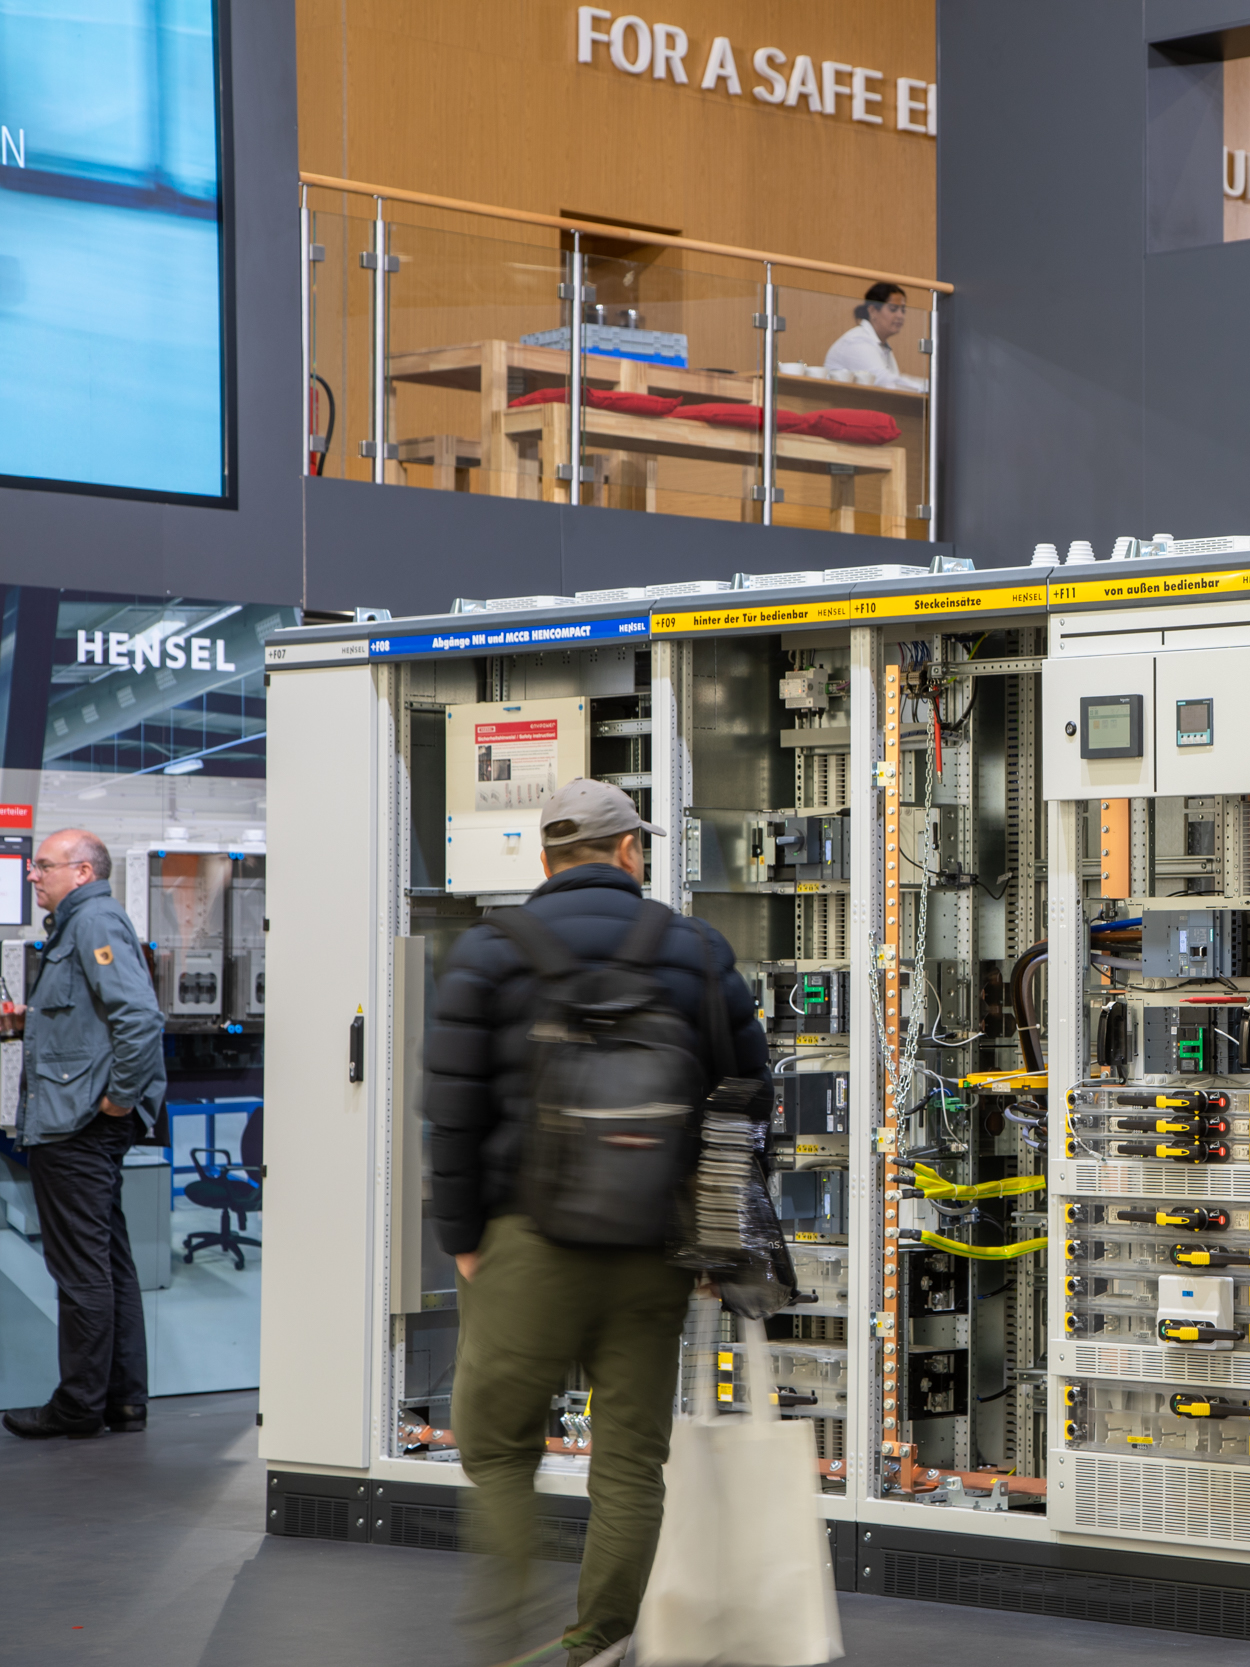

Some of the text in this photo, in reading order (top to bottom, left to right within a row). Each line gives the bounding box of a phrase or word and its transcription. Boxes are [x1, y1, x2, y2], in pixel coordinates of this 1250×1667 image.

[578, 5, 689, 85] FOR
[701, 36, 742, 95] A
[752, 46, 883, 125] SAFE
[1053, 587, 1076, 599] +F11
[1104, 578, 1220, 596] von außen bedienbar
[914, 597, 982, 609] Steckeinsätze
[1012, 592, 1042, 603] HENSEL
[817, 607, 846, 617] HENSEL
[854, 602, 876, 614] +F10
[655, 617, 676, 628] +F09
[693, 610, 808, 626] hinter der Tür bedienbar
[618, 622, 646, 633] HENSEL
[432, 625, 591, 650] Abgänge NH und MCCB HENCOMPACT
[77, 627, 236, 675] HENSEL
[341, 645, 365, 655] HENSEL
[370, 640, 390, 652] +F08
[268, 649, 286, 660] +F07
